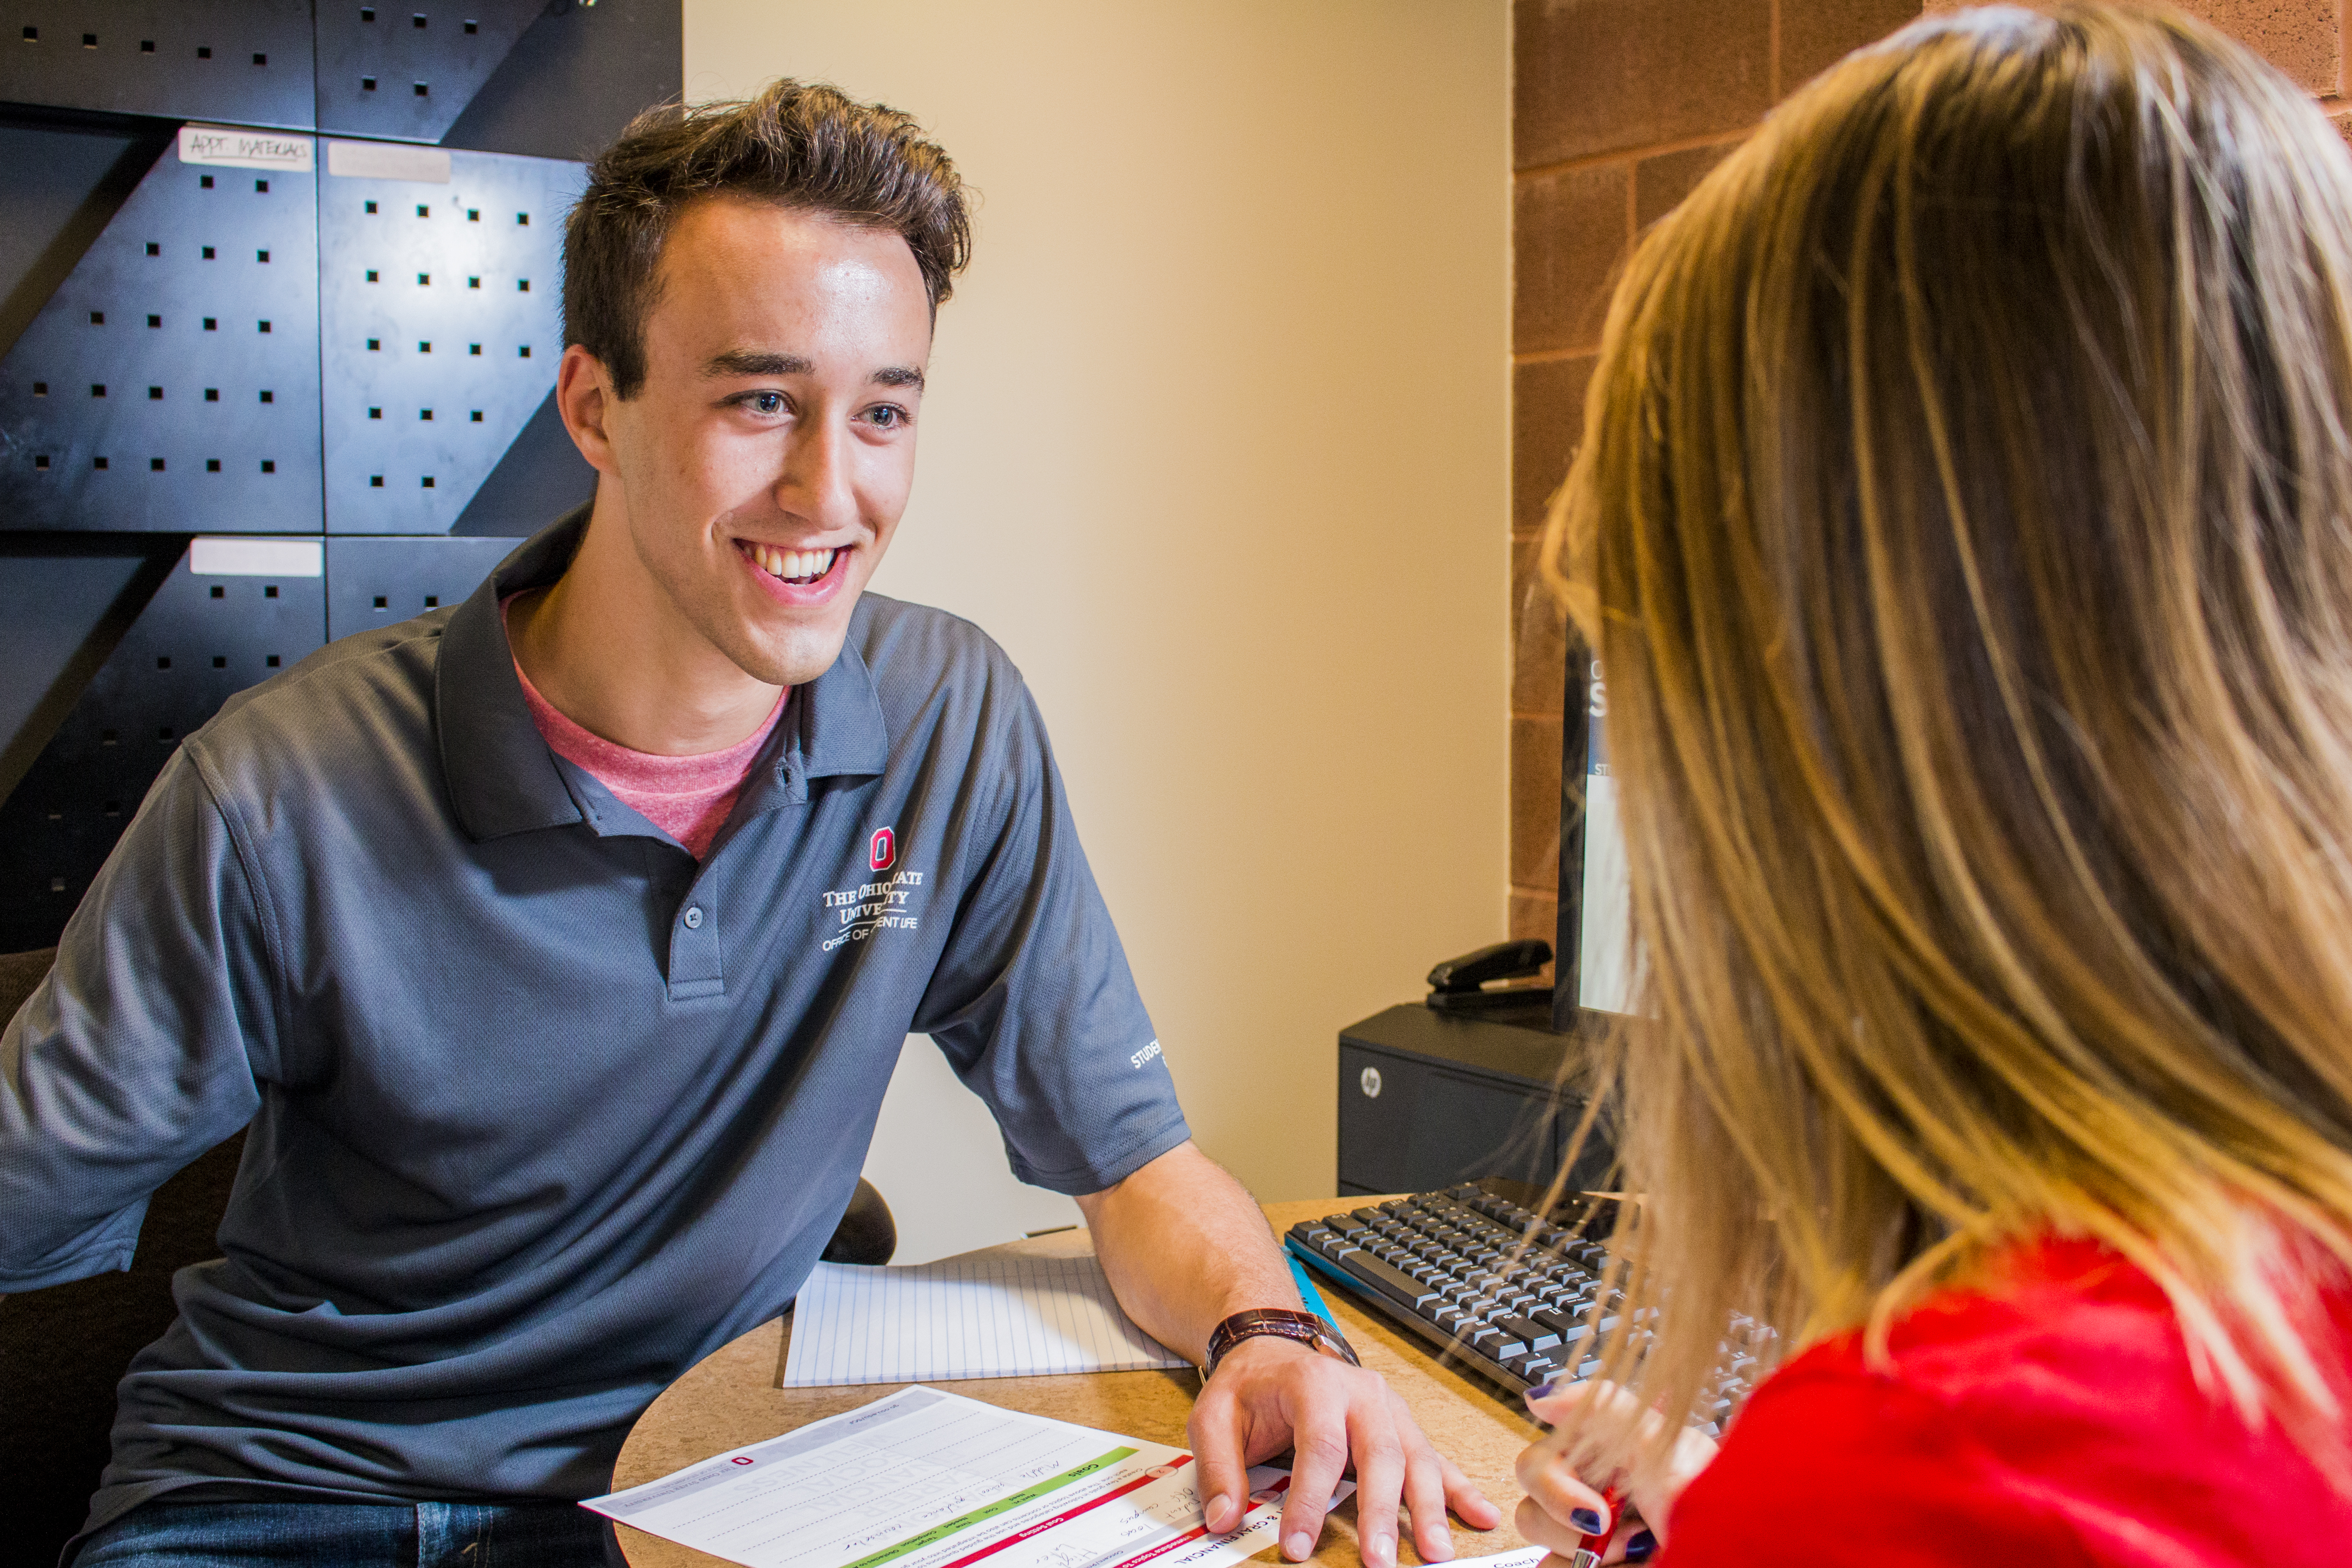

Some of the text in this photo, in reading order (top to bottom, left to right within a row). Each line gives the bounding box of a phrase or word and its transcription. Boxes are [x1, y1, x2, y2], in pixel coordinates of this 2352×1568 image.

[823, 891, 857, 907] THE
[858, 882, 892, 900] OHIO
[852, 929, 869, 940] OF
[900, 918, 918, 929] LIFE
[1068, 1464, 1099, 1479] Goals
[1122, 1468, 1143, 1479] Create
[1008, 1493, 1026, 1502] Need
[1089, 1485, 1106, 1495] goals
[1021, 1493, 1038, 1503] Want
[1053, 1495, 1084, 1510] following
[943, 1517, 969, 1529] Needed
[1021, 1508, 1053, 1526] categories
[1019, 1517, 1064, 1538] Goal Setting
[1237, 1521, 1268, 1537] GRAY
[900, 1530, 937, 1547] Completion
[915, 1536, 937, 1547] Target
[960, 1539, 983, 1552] guided
[1154, 1535, 1193, 1555] Immediate
[867, 1549, 899, 1563] Obstacles
[926, 1549, 959, 1566] questions
[1131, 1552, 1157, 1563] Topics
[1173, 1536, 1239, 1565] FINANCIAL
[1493, 1557, 1540, 1568] Coach
